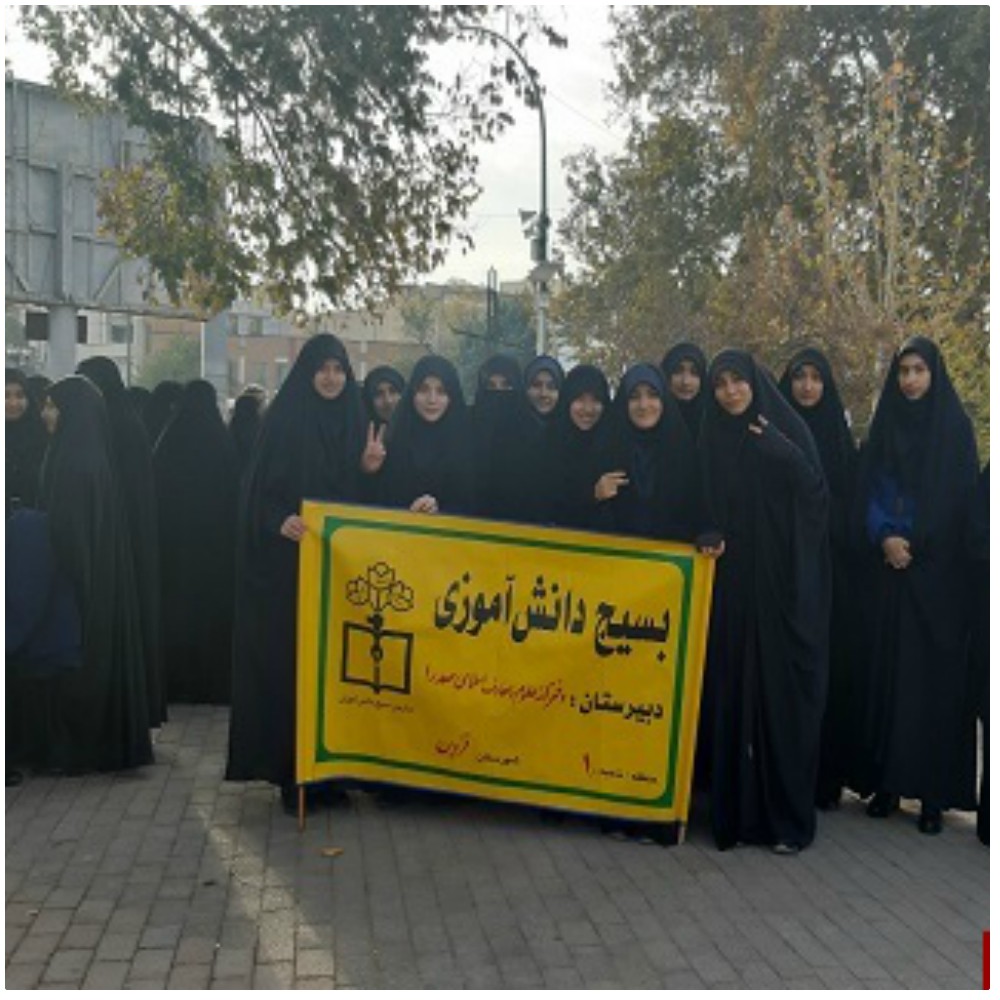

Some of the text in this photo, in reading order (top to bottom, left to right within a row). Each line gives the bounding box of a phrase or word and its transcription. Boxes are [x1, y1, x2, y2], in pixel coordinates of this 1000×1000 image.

[434, 571, 671, 663] بسیج دانش آموزی
